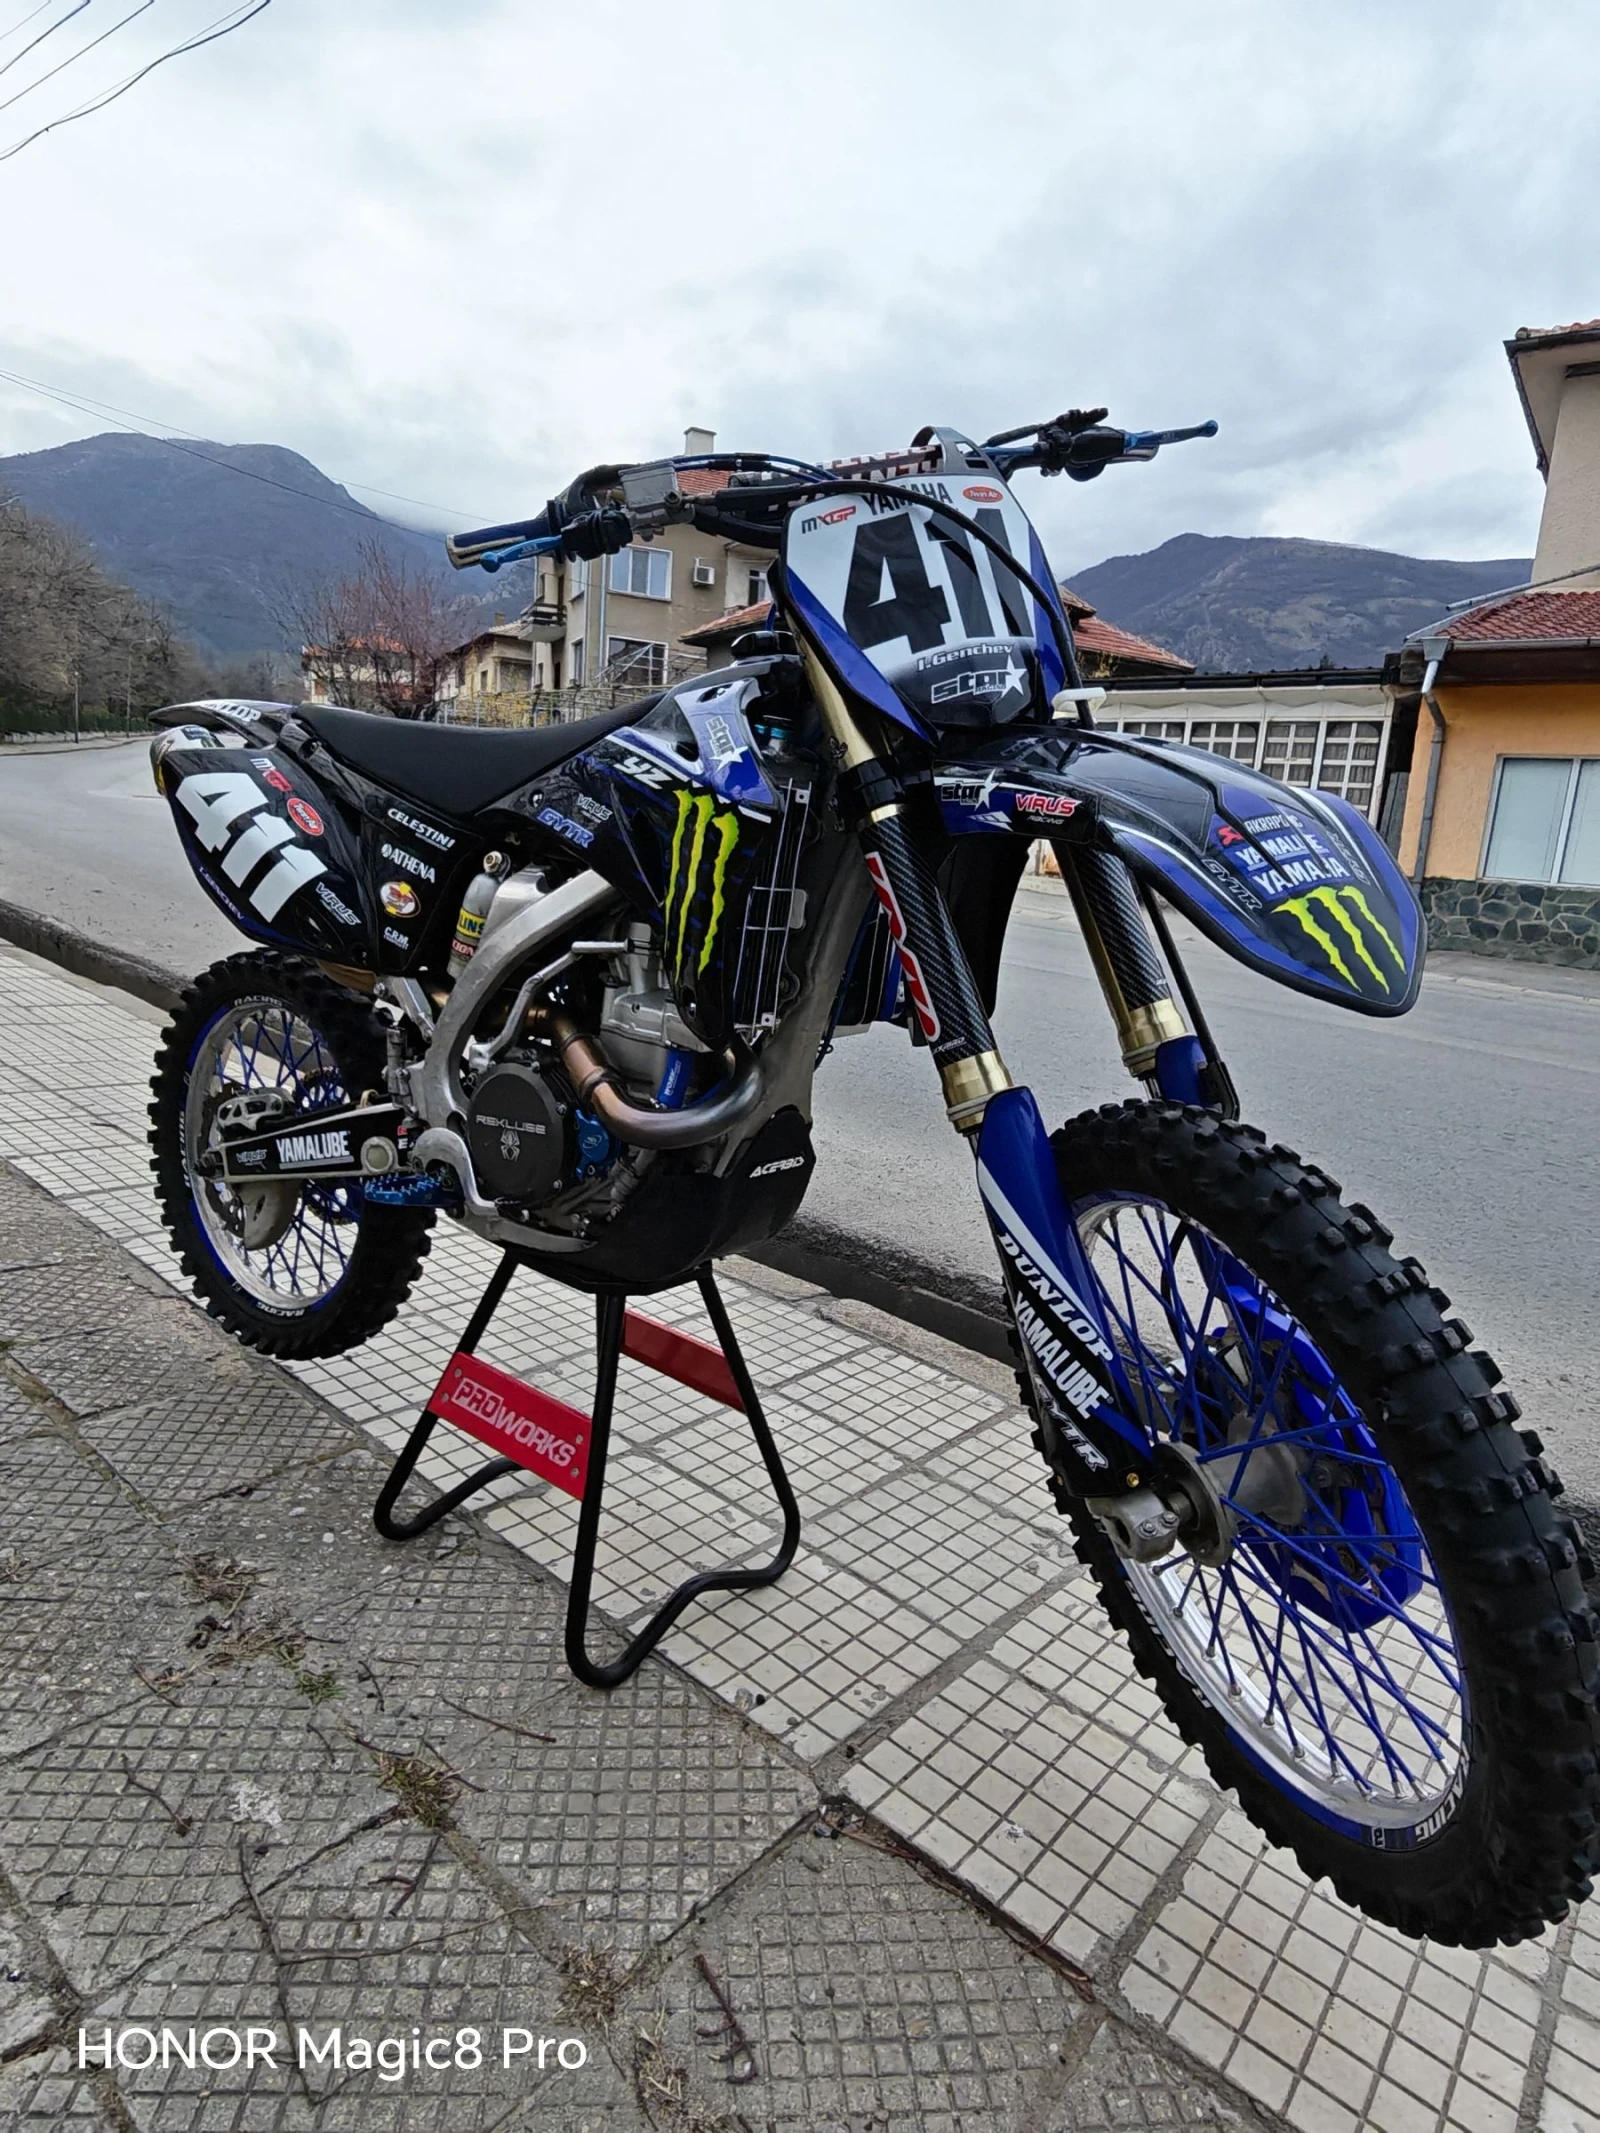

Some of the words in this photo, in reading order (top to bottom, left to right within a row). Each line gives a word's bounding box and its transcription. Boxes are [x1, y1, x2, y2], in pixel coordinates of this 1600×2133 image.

[842, 508, 1034, 655] 411
[614, 756, 673, 789] YZ
[576, 793, 613, 821] VIRUS
[1015, 793, 1083, 817] VIRUS
[175, 772, 328, 923] 411
[387, 807, 455, 848] CELESTINI
[536, 806, 595, 849] GYTR
[389, 847, 435, 884] ATHENA
[315, 881, 362, 925] VIRUS
[476, 1114, 546, 1135] REKLUSE
[998, 1232, 1114, 1362] DUNLOP
[1034, 1374, 1109, 1472] GYTR
